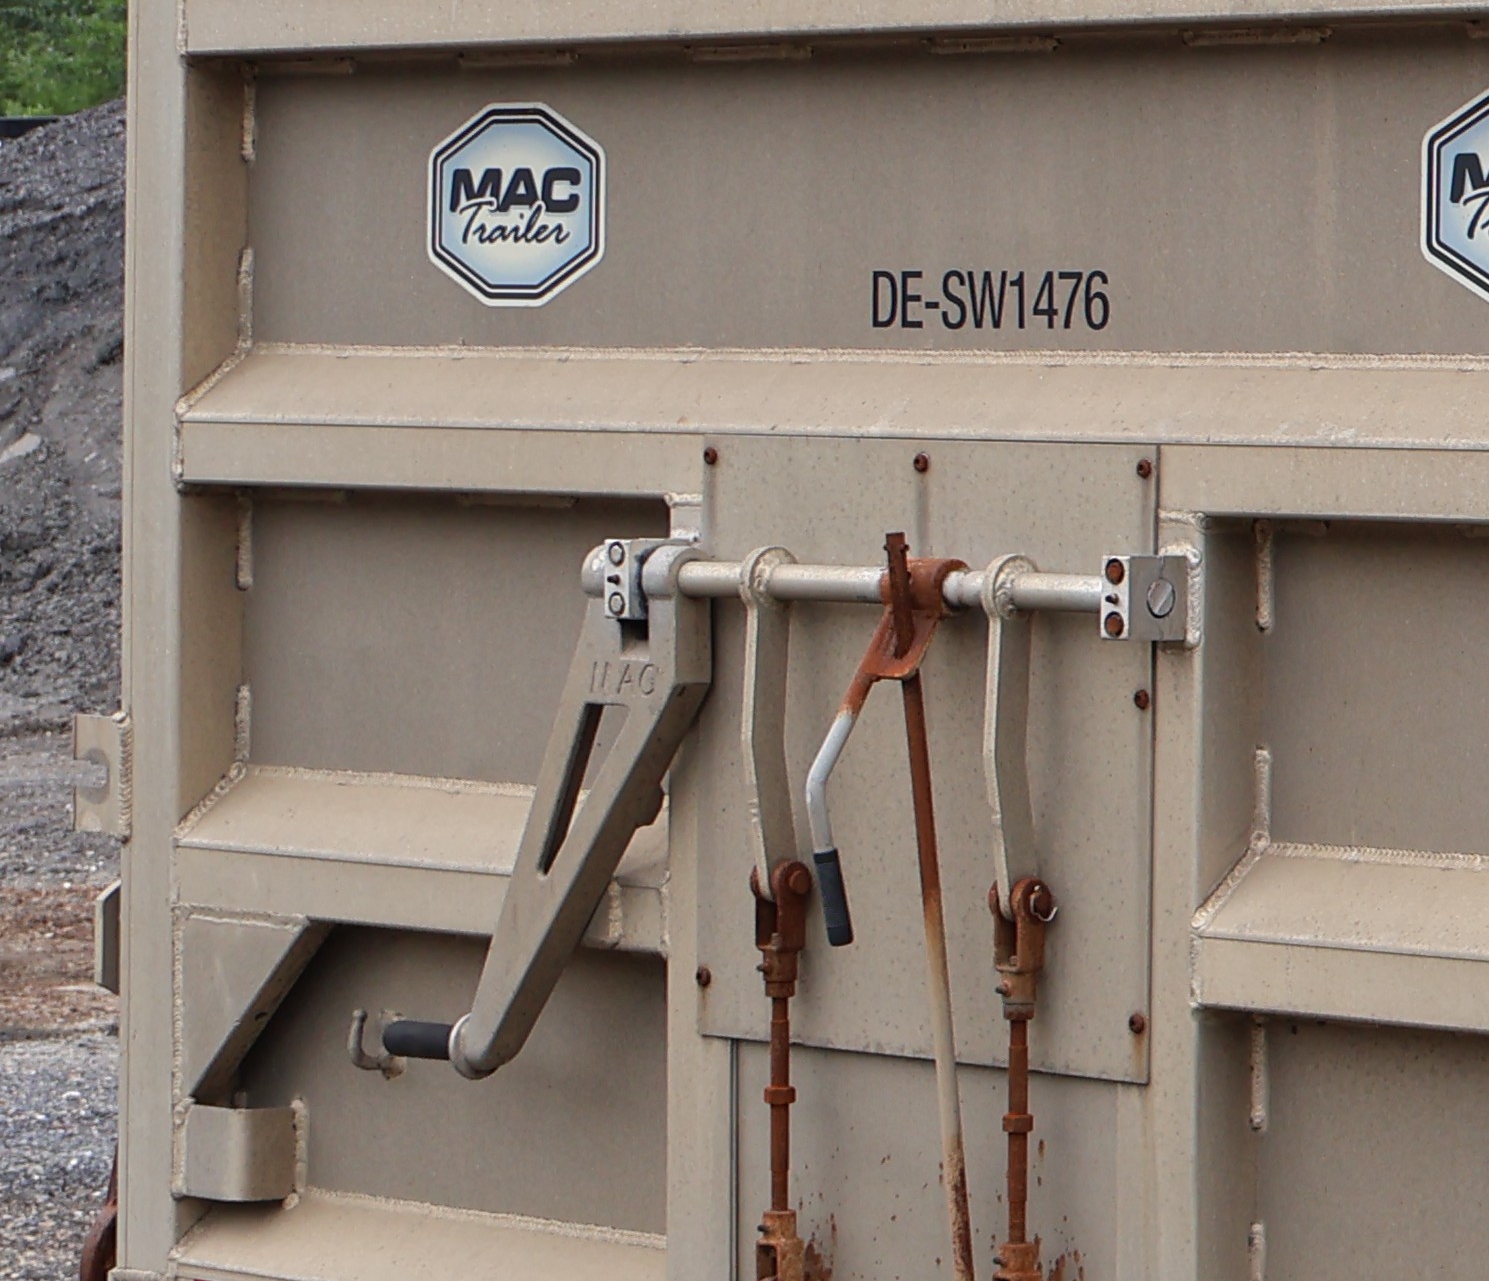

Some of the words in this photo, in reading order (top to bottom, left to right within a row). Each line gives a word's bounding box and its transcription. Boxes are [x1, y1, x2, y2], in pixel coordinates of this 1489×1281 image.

[450, 167, 581, 213] MAC
[459, 200, 570, 244] Trailer
[872, 270, 1110, 330] DE-SW1476
